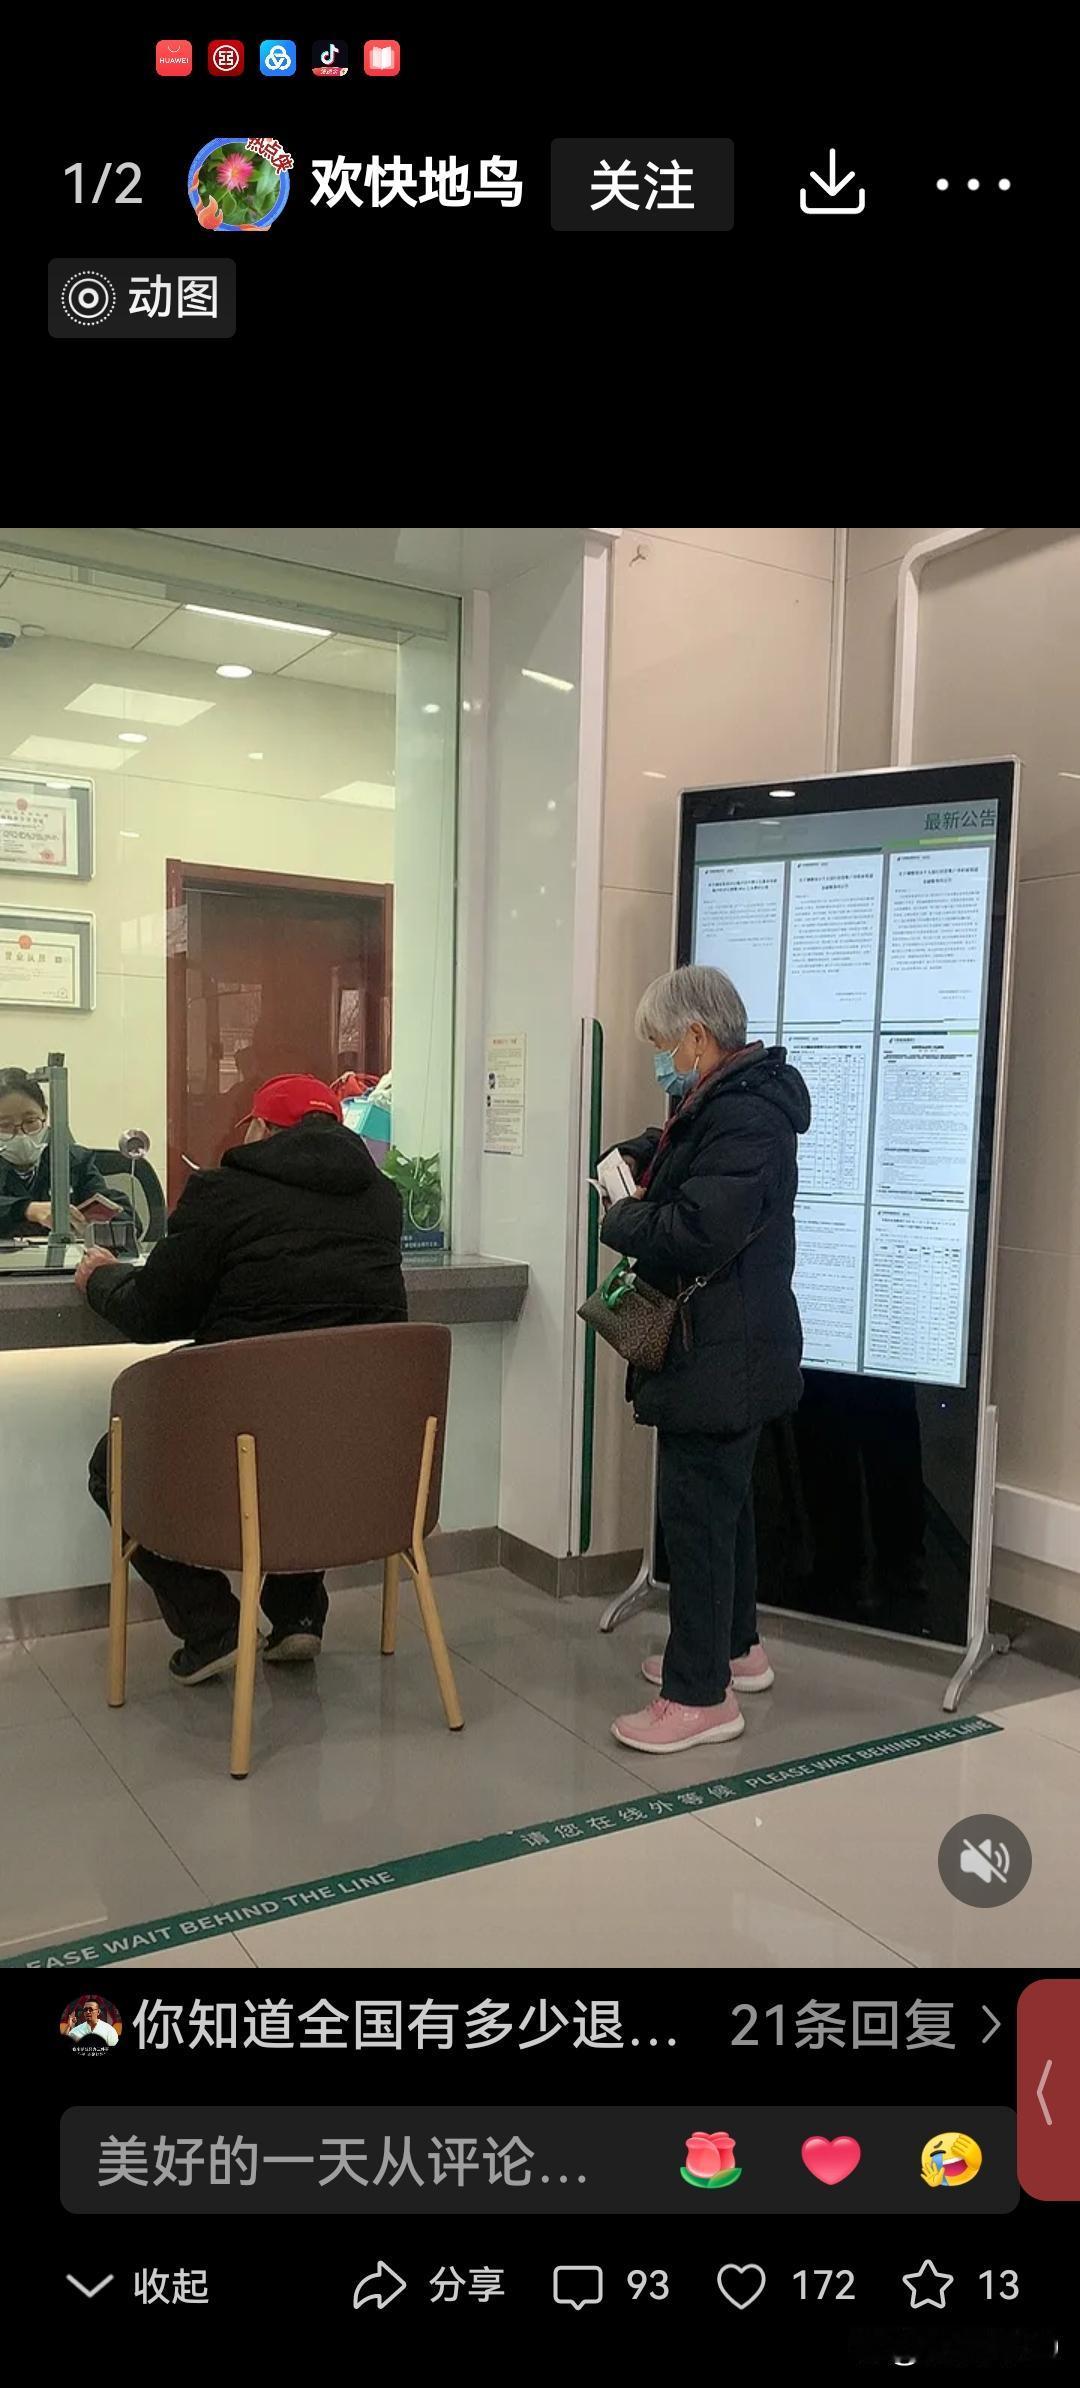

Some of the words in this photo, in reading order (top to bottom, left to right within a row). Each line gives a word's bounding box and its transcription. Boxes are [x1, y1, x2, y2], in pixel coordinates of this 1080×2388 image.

[924, 809, 996, 831] 最新公告
[745, 1764, 815, 1789] PLEASE
[813, 1753, 859, 1773] WAIT
[858, 1737, 921, 1760] BEHIND
[919, 1725, 955, 1746] THE
[953, 1719, 993, 1736] LINE
[521, 1784, 736, 1847] 请您在线外等候
[102, 1927, 172, 1954] WAIT
[179, 1901, 280, 1935] BEHIND
[282, 1885, 336, 1908] THE
[337, 1871, 396, 1894] LINE
